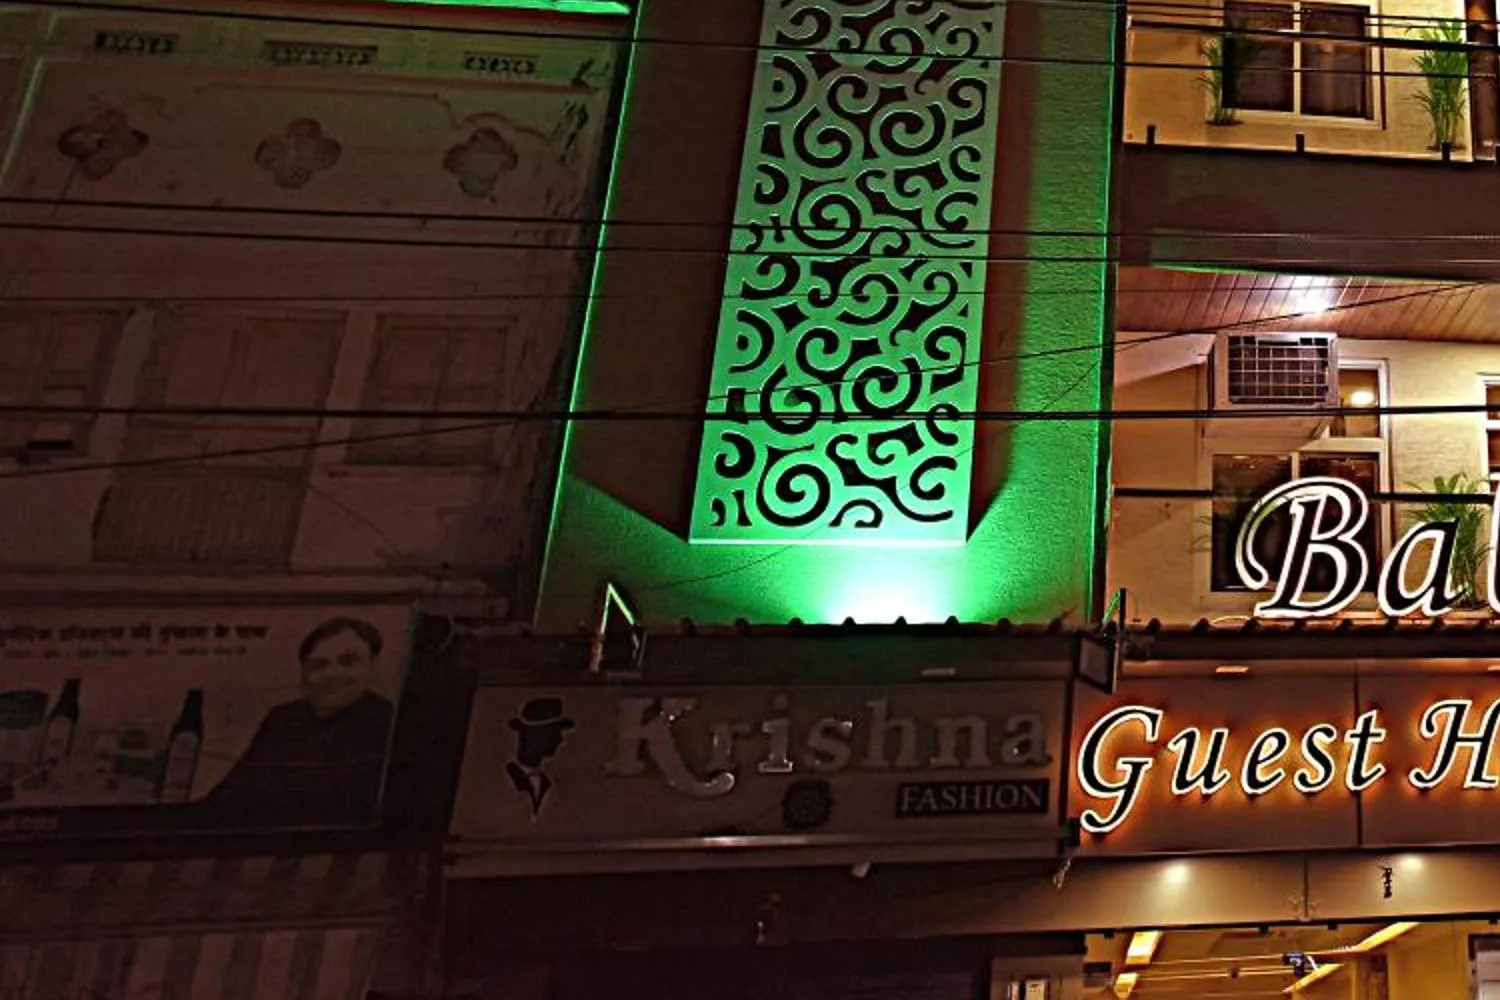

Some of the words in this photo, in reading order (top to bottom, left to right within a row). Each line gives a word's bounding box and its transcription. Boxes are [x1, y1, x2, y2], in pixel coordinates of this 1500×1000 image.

[602, 695, 1052, 797] Krishna
[1078, 706, 1387, 834] Guest
[900, 785, 1045, 811] FASHION
